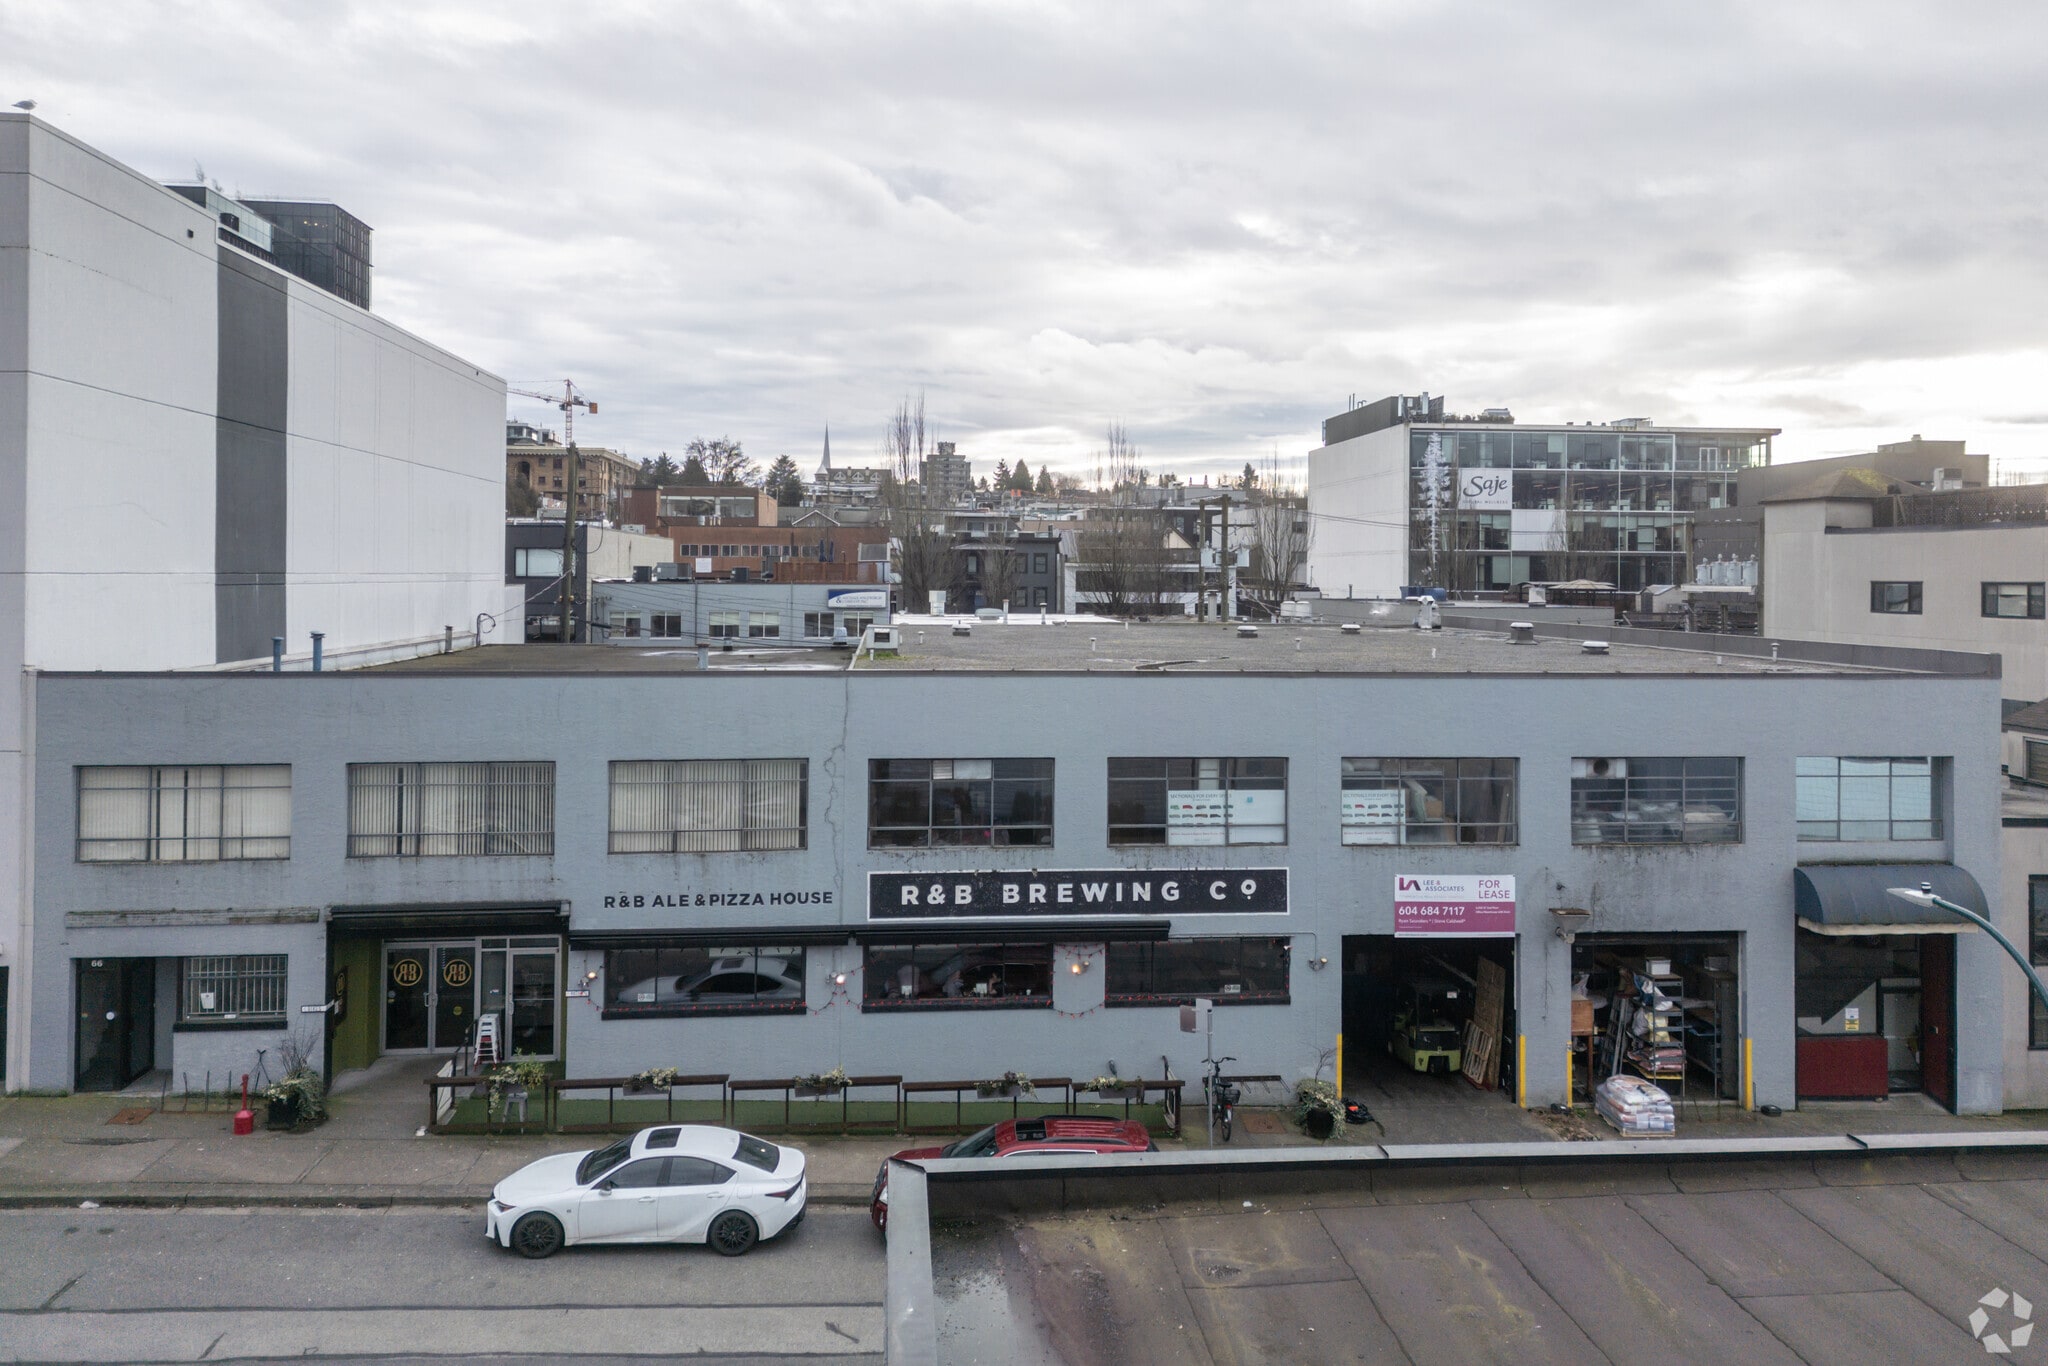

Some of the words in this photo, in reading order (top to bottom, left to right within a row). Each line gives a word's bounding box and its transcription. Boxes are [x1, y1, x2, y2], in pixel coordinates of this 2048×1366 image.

[1462, 475, 1508, 497] Saje
[1478, 879, 1500, 889] FOR
[901, 884, 972, 905] R&B
[1002, 881, 1180, 904] BREWING
[1209, 879, 1256, 900] CO
[1478, 889, 1511, 899] LEASE
[603, 895, 645, 908] R&B
[652, 894, 690, 907] ALE
[770, 891, 833, 905] HOUSE
[1398, 906, 1418, 916] 604
[1420, 906, 1440, 916] 684
[1442, 906, 1465, 916] 7117
[91, 960, 103, 968] 66
